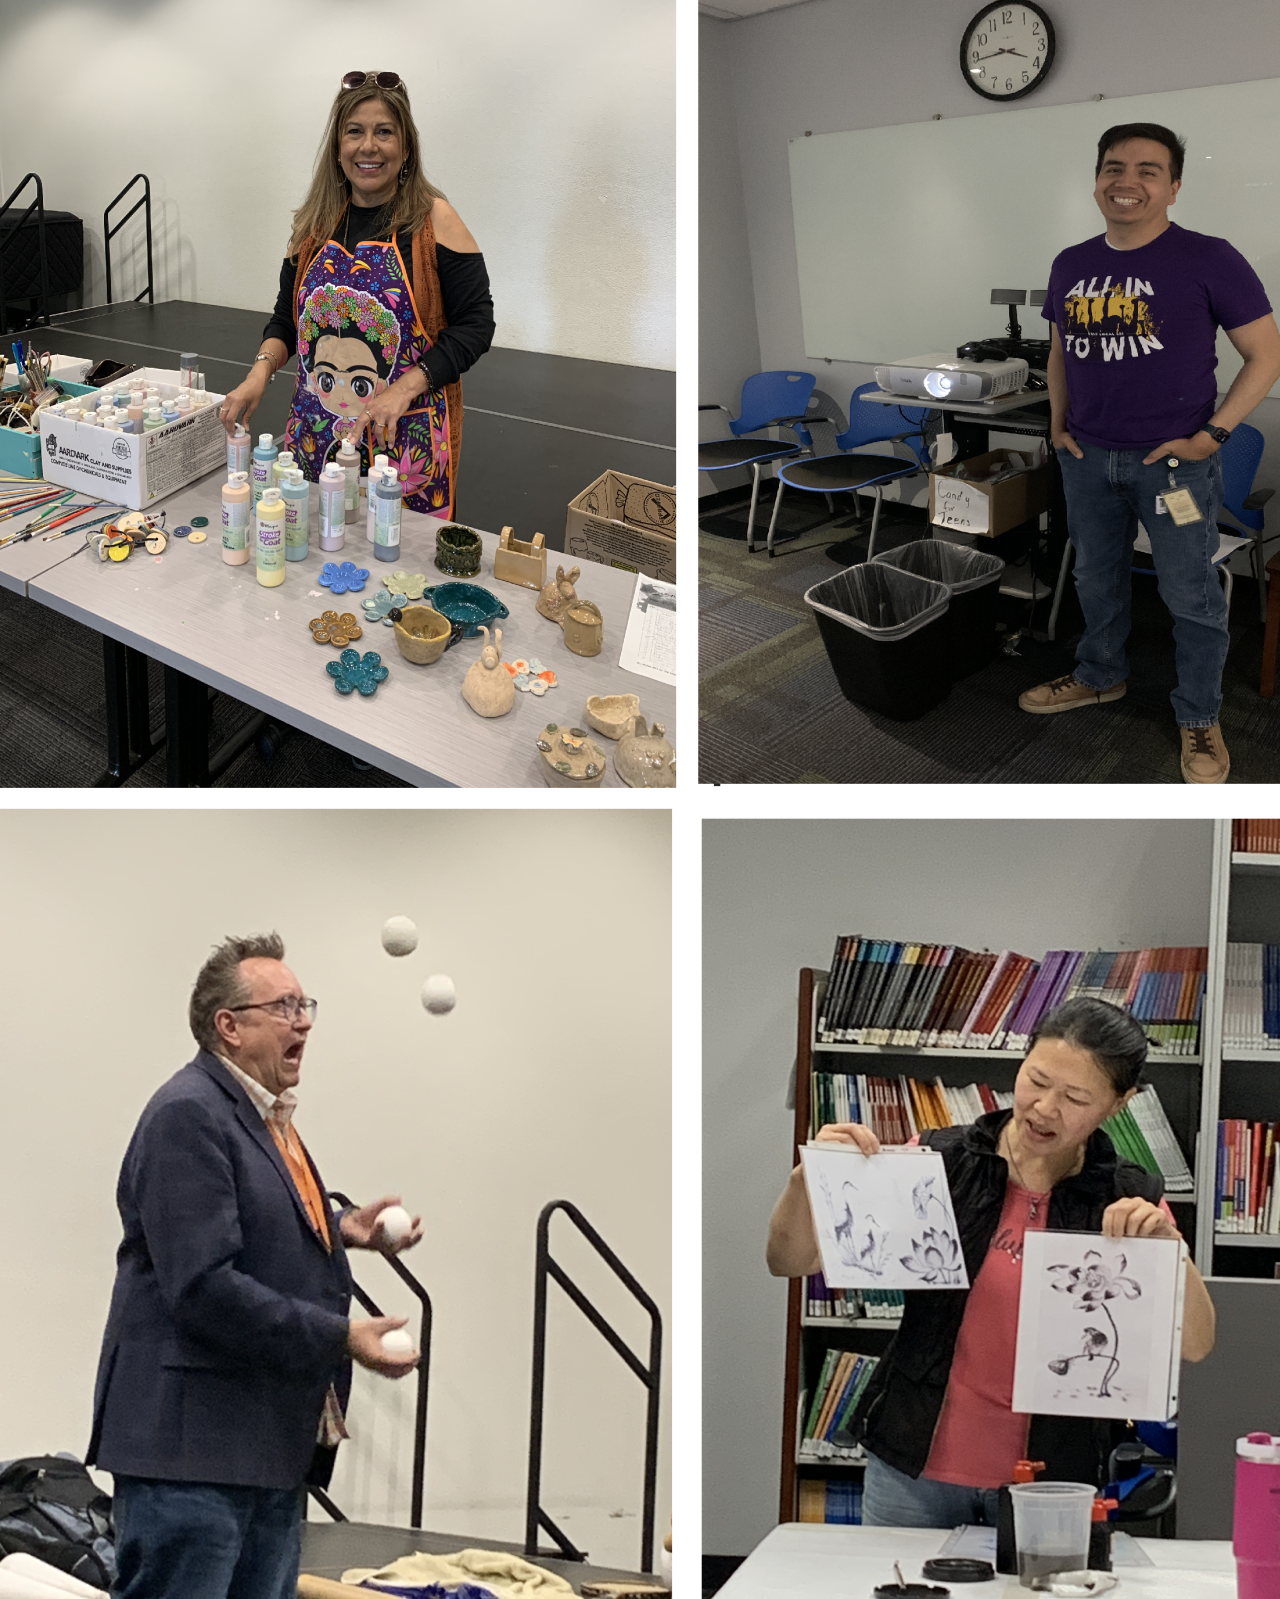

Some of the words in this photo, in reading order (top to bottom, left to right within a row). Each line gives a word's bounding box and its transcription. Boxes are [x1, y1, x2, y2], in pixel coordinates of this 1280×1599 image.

[1002, 10, 1012, 24] 12
[989, 19, 997, 32] 11
[1032, 22, 1040, 36] 2
[977, 33, 988, 47] 10
[1037, 38, 1046, 52] 3
[972, 51, 980, 63] 9
[1032, 56, 1040, 69] 4
[978, 66, 986, 78] 8
[1021, 71, 1029, 83] 5
[991, 76, 998, 89] 7
[1005, 78, 1013, 90] 6
[1064, 275, 1116, 299] ALL
[1124, 276, 1155, 298] IN
[1064, 334, 1090, 359] TO
[1101, 334, 1165, 362] WIN
[58, 446, 90, 463] AARDVARK
[938, 480, 970, 508] Candy
[938, 511, 971, 526] Teens
[262, 537, 281, 546] Coat
